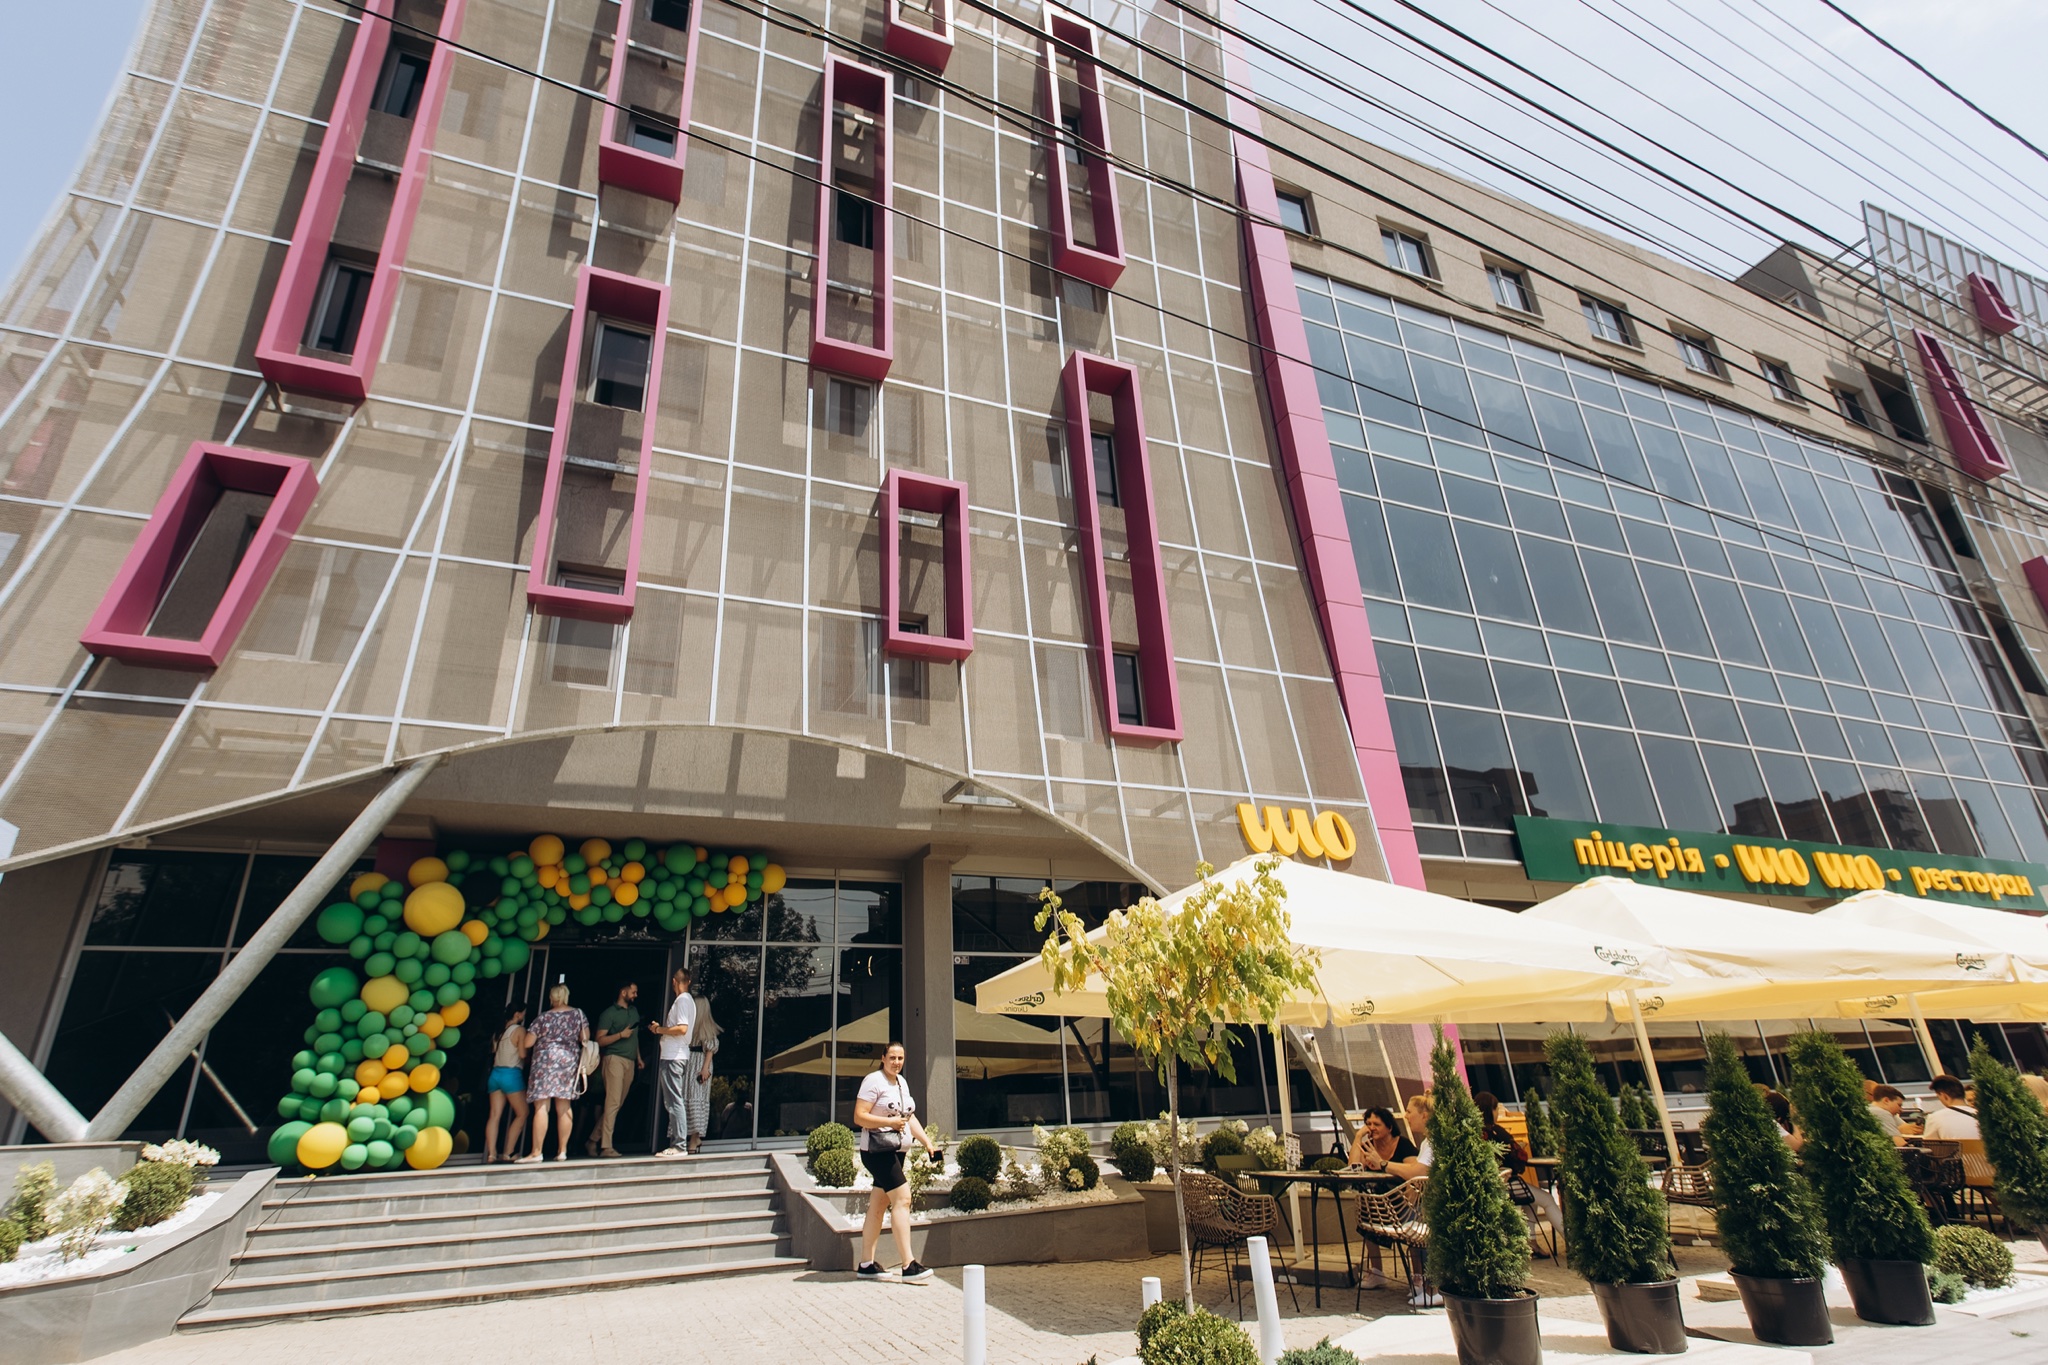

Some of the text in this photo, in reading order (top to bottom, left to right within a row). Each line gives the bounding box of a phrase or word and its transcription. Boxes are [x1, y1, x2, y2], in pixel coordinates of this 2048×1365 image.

[1574, 831, 1706, 879] піцерія
[1909, 866, 2035, 901] ресторан
[1594, 946, 1640, 967] Carlsberg
